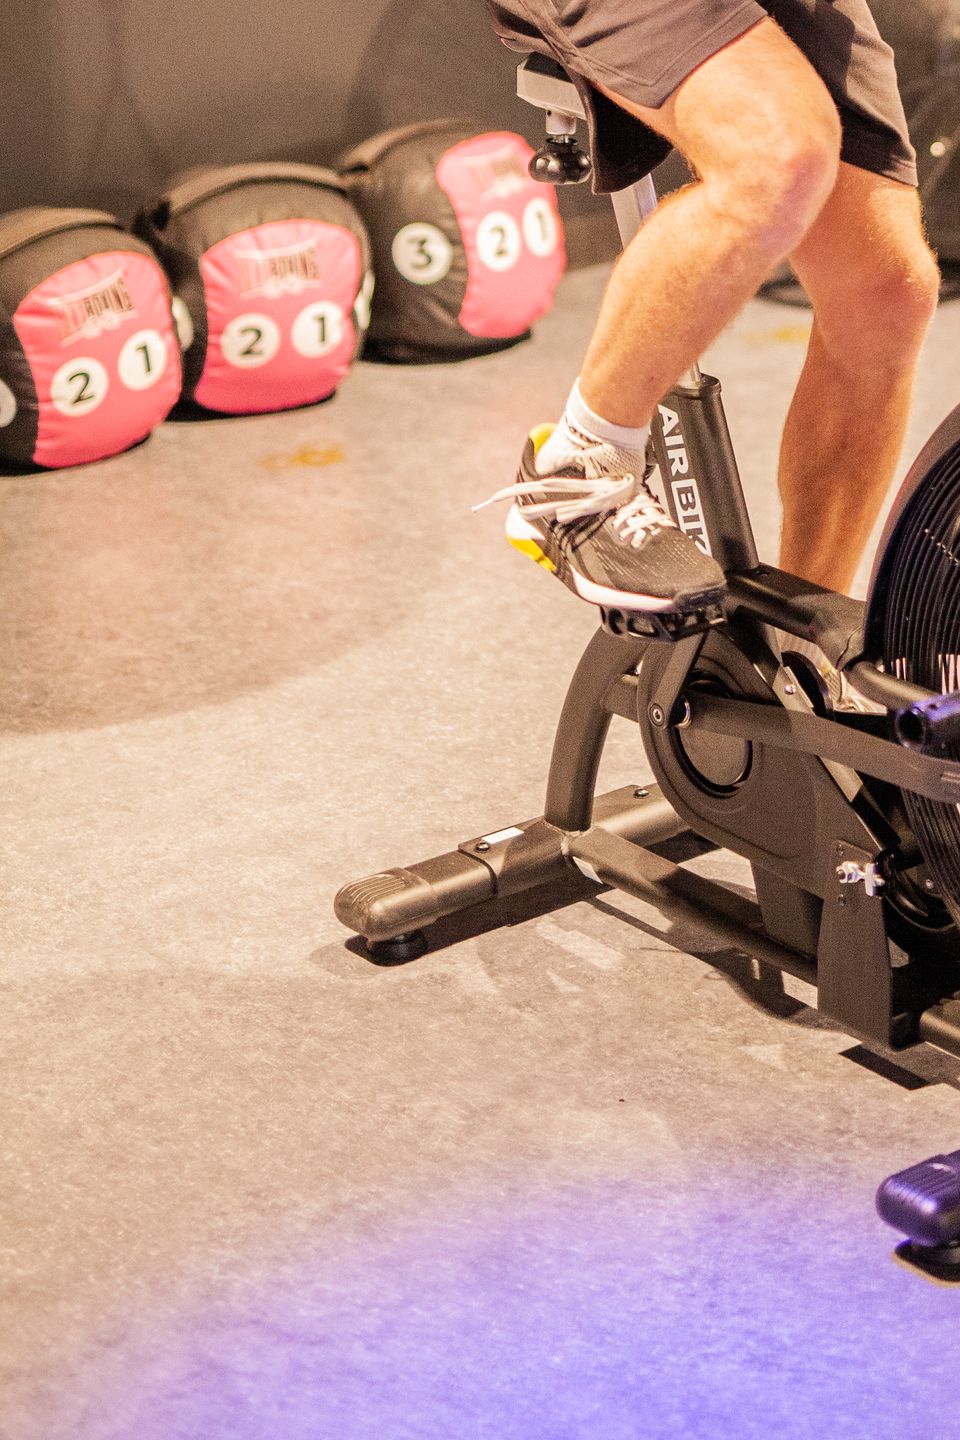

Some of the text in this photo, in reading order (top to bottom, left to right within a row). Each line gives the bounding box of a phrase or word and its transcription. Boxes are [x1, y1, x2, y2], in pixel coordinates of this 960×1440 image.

[407, 237, 432, 270] 3
[490, 225, 507, 257] 2
[239, 315, 326, 356] 2 1
[67, 343, 151, 406] 2 1
[657, 404, 707, 551] AIR BIK
